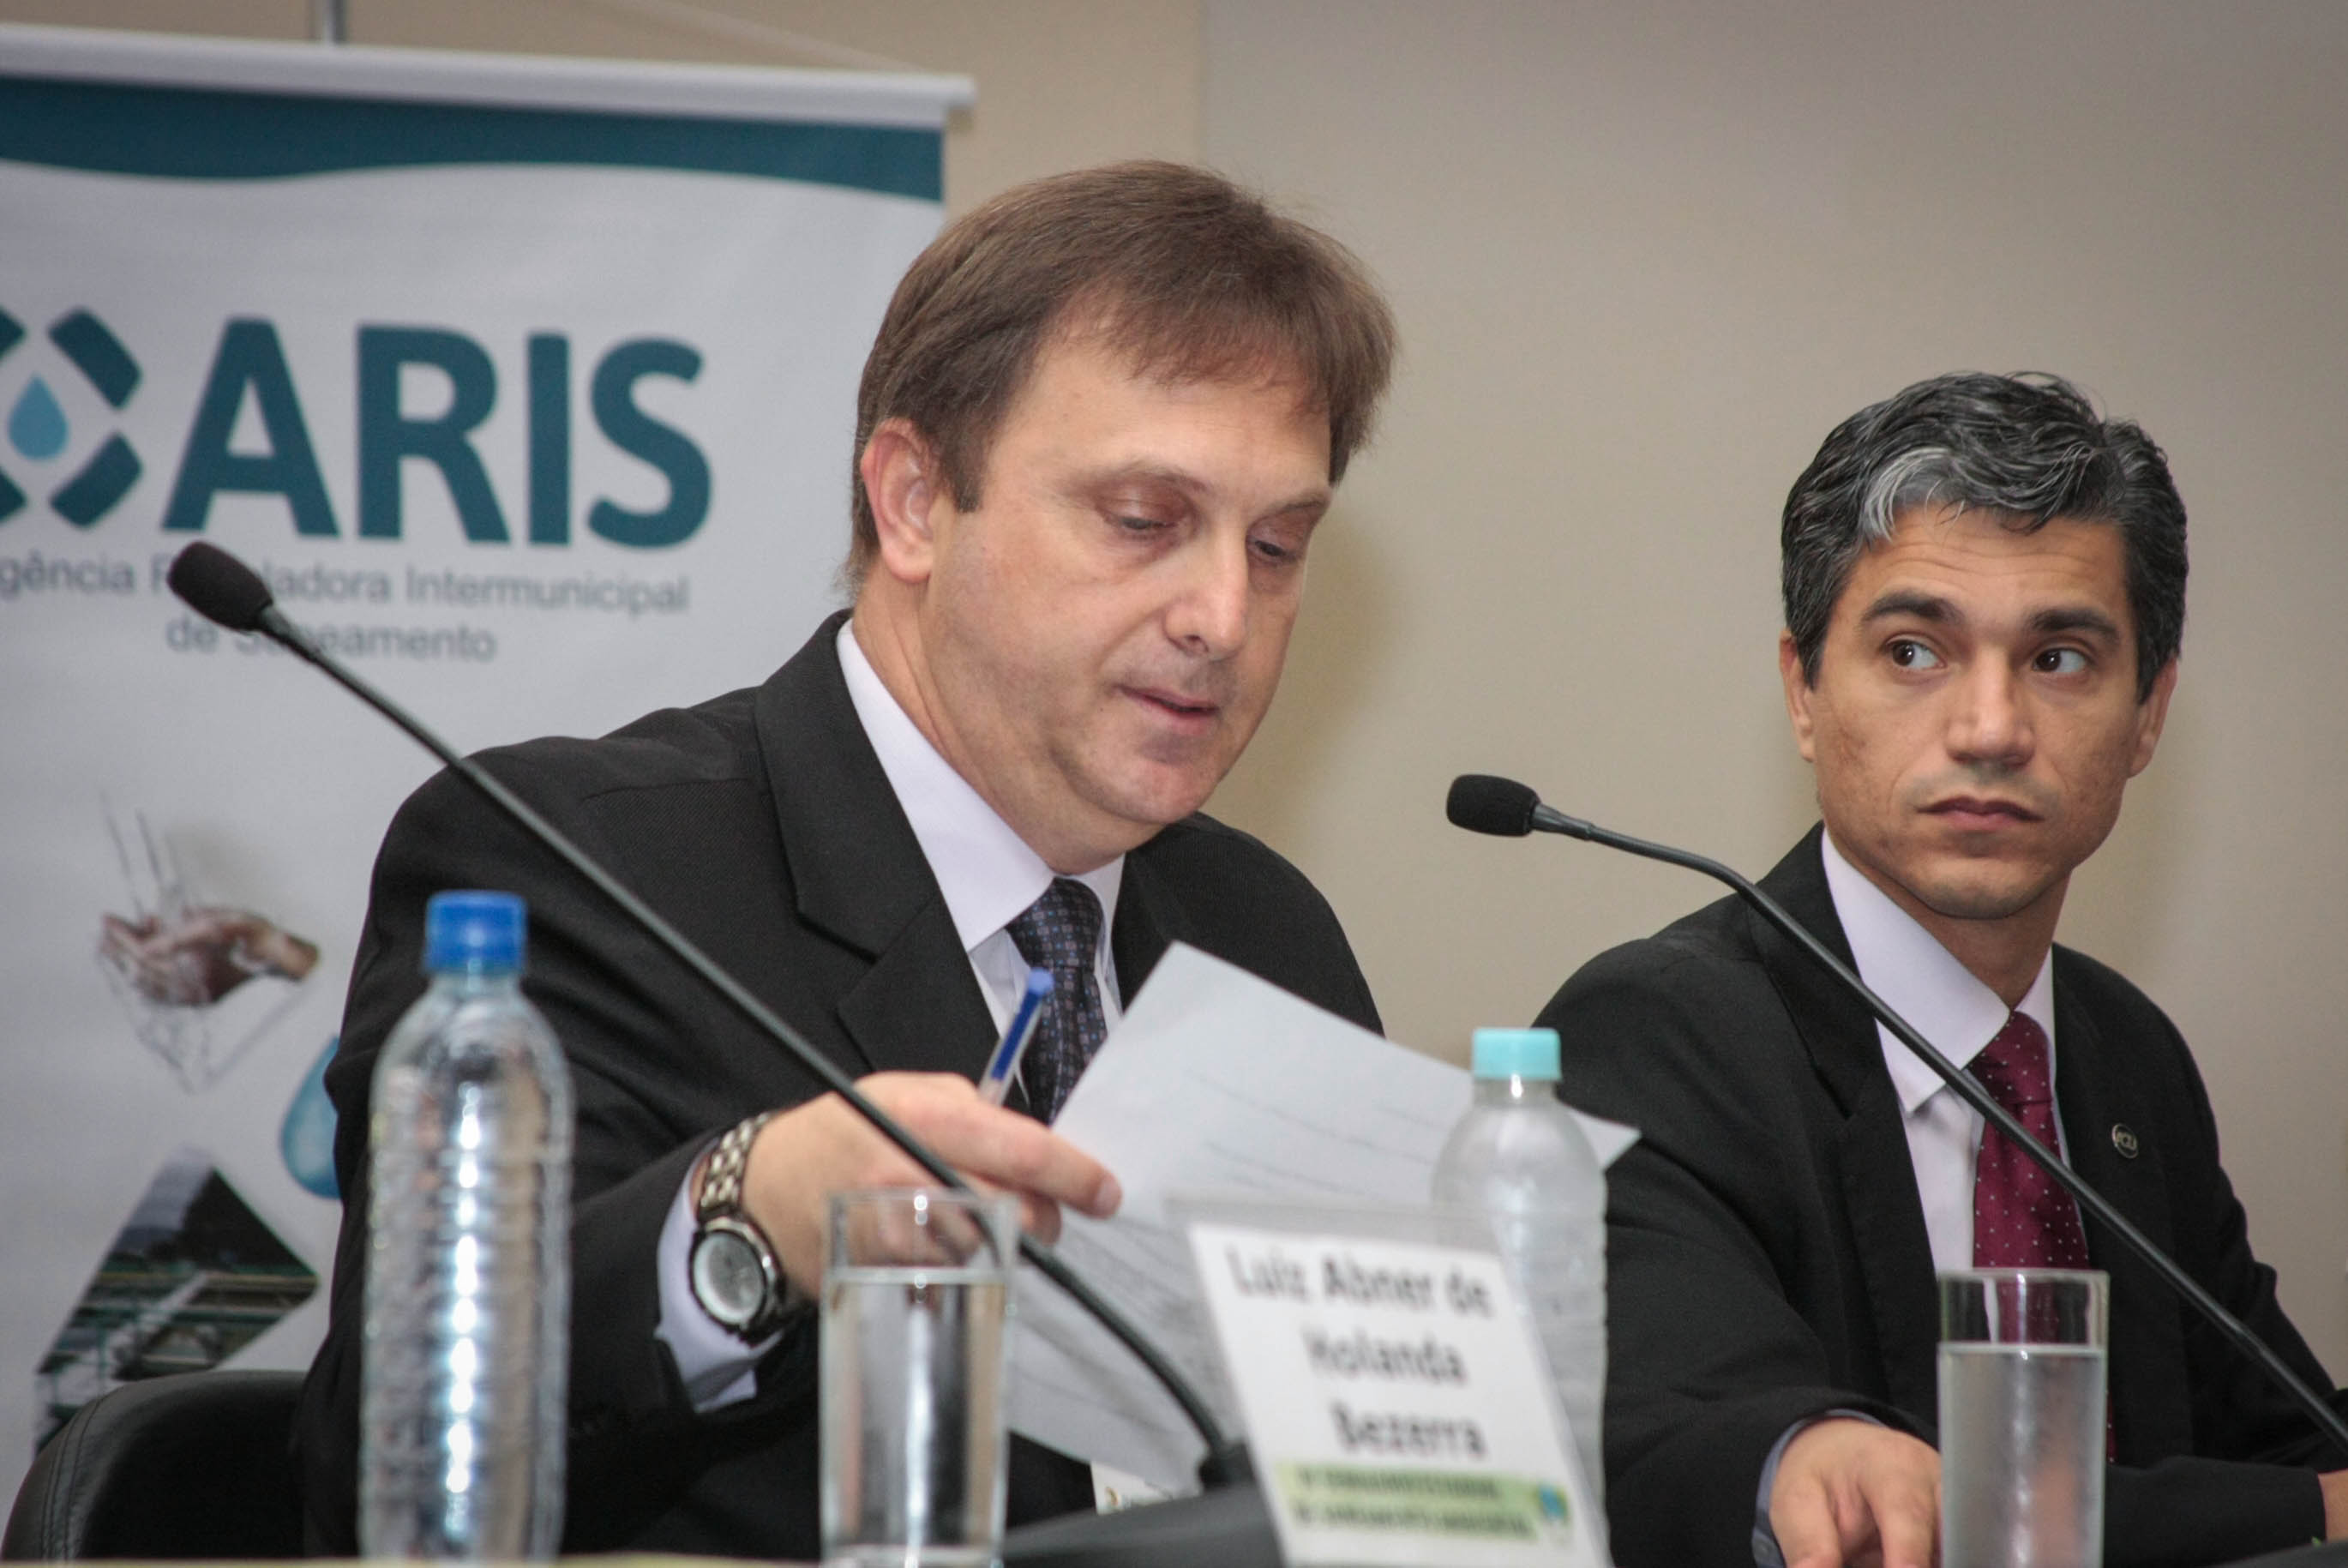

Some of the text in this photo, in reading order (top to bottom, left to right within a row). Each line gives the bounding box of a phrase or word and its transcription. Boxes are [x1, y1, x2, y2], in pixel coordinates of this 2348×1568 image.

[162, 317, 712, 550] ARIS
[0, 550, 689, 621] gência Rladora Intermunicipal
[166, 614, 497, 662] de Seamento
[1226, 1243, 1495, 1319] Luiz Abner de
[1300, 1327, 1470, 1387] Holanda
[1330, 1399, 1488, 1461] Bezerra
